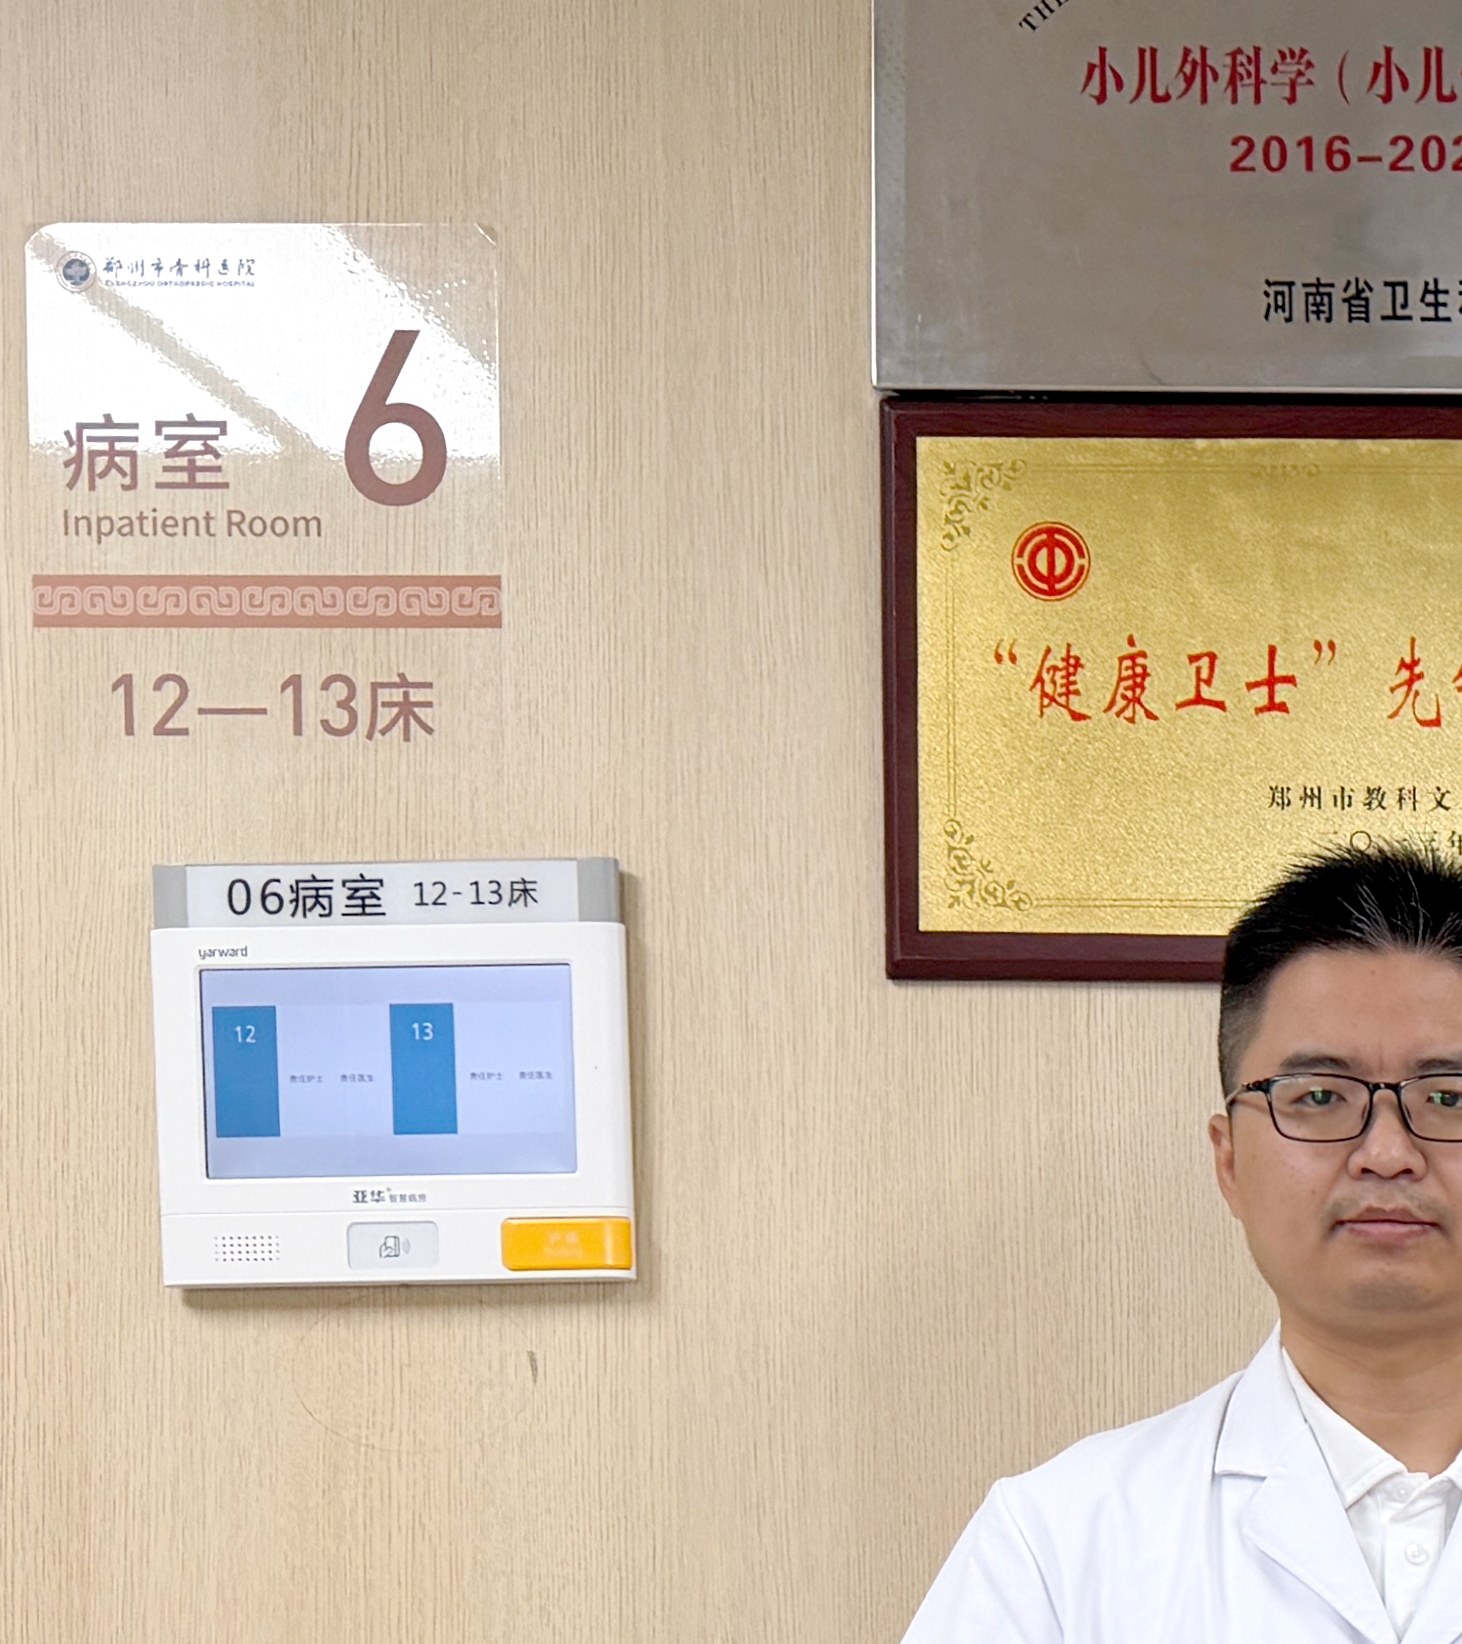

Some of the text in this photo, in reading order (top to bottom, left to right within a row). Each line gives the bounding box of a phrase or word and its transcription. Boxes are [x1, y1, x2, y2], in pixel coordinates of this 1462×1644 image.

[344, 329, 448, 507] 6
[62, 413, 231, 493] 病室
[62, 508, 323, 544] Inpatient Room
[226, 873, 540, 920] 06病室 12-13床
[198, 945, 248, 960] yarward
[234, 1024, 257, 1043] 12
[411, 1021, 434, 1040] 13
